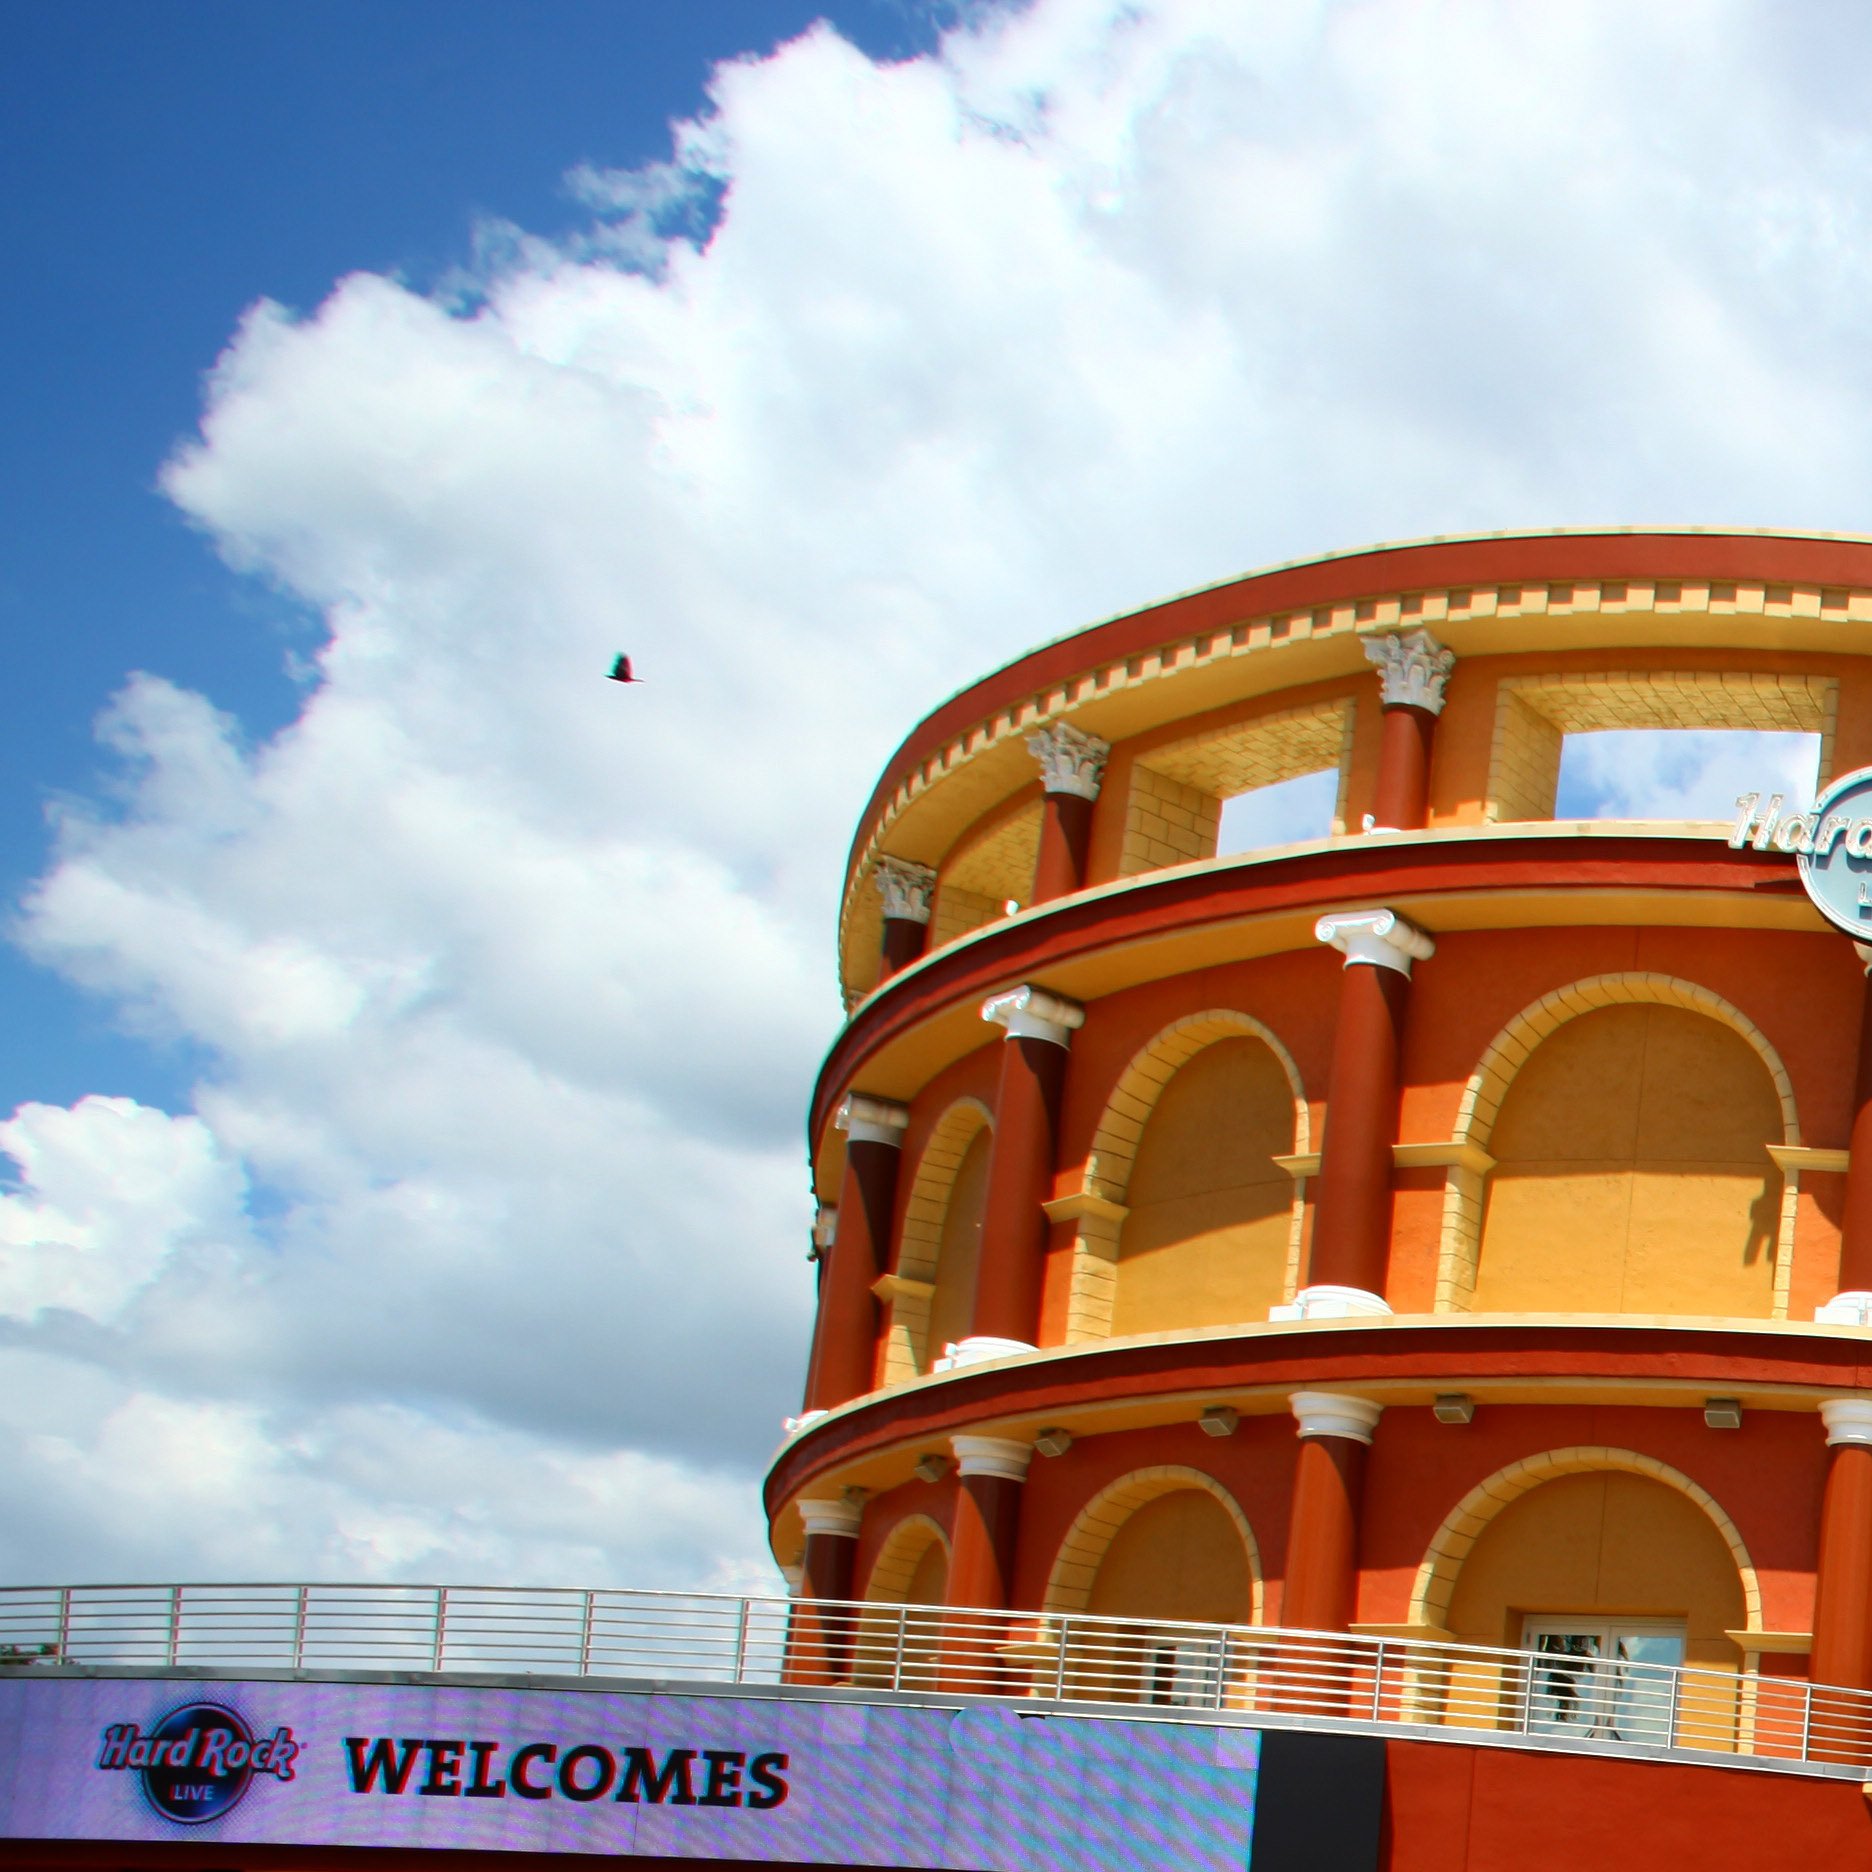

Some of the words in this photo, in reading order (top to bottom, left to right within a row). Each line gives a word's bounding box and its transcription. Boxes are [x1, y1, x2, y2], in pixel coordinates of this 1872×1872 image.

[98, 1724, 200, 1769] Hard
[196, 1727, 300, 1781] Rock
[342, 1737, 789, 1809] WELCOMES
[170, 1784, 215, 1800] LIVE
